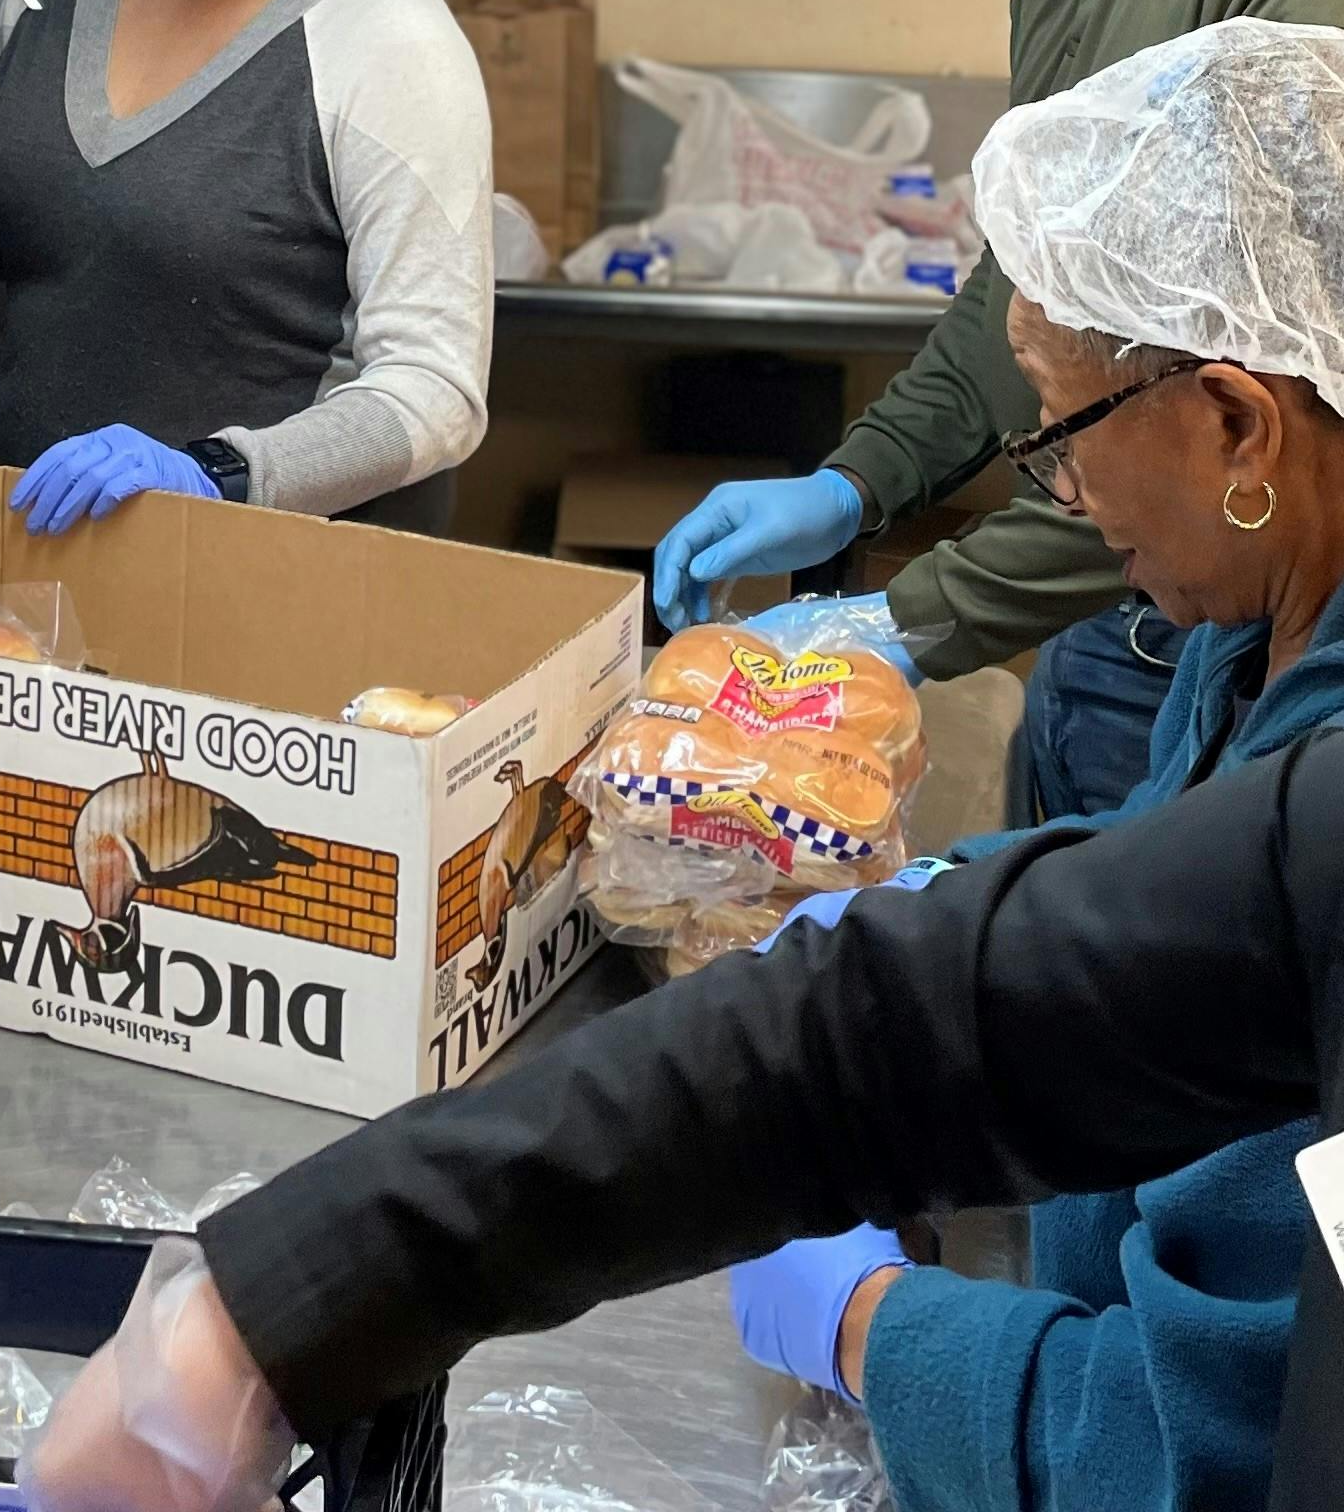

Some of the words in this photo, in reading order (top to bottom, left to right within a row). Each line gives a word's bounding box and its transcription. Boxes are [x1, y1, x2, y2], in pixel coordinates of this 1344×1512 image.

[53, 682, 185, 759] RIVER
[197, 713, 357, 795] HOOD
[447, 989, 474, 1022] brand
